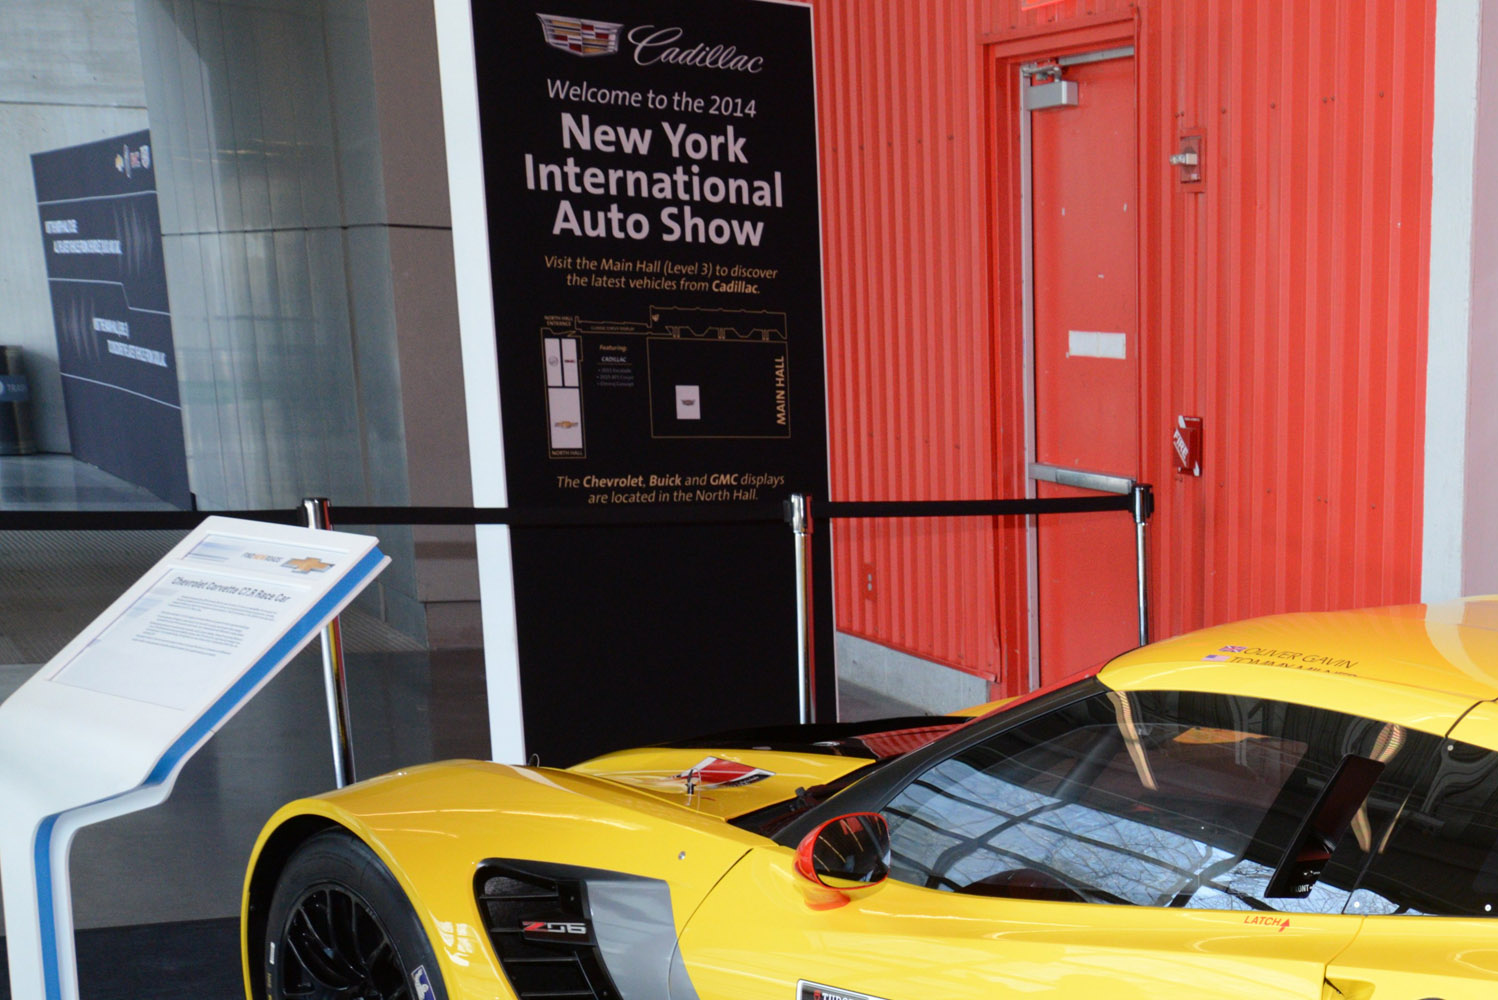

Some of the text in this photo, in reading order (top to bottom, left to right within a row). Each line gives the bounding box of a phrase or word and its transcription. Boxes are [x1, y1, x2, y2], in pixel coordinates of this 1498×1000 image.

[628, 25, 764, 73] Cadillac
[547, 78, 757, 118] Welcome to the 2014
[560, 111, 748, 164] New York
[524, 153, 783, 208] International
[552, 199, 764, 247] Auto Show
[544, 255, 778, 279] Visit the Main Hall (Level 3) to discover
[566, 272, 760, 294] the latest vehicles from Cadillac.
[774, 355, 786, 425] MAIN HALL
[1173, 428, 1189, 461] FIRE
[557, 473, 785, 489] The Chevrolet, Buick and GMC displays
[588, 488, 758, 504] are located in the North Hall.
[171, 576, 208, 589] Chevrolet
[206, 582, 239, 595] Corvette
[258, 589, 276, 601] Race
[274, 593, 291, 603] Car
[1244, 647, 1359, 669] OLIVER GAVIN
[522, 921, 587, 934] Z06
[1244, 915, 1282, 926] LATCH
